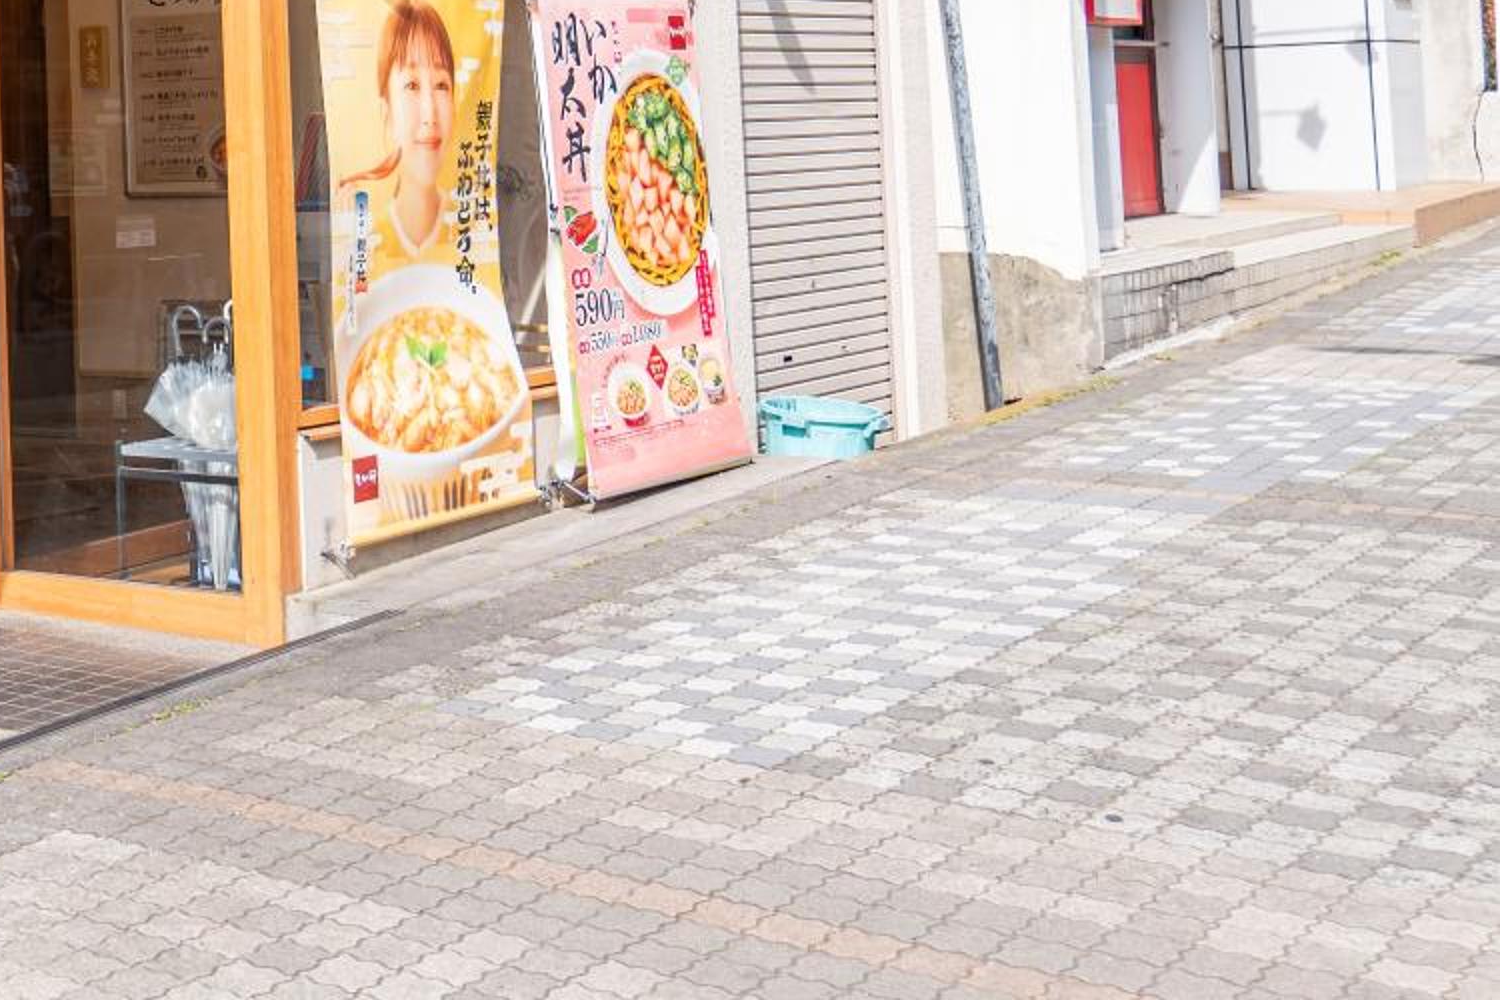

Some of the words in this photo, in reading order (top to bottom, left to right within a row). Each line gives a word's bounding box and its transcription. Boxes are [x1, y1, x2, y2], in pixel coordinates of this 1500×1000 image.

[552, 12, 591, 182] 明太丼
[580, 19, 617, 105] いか
